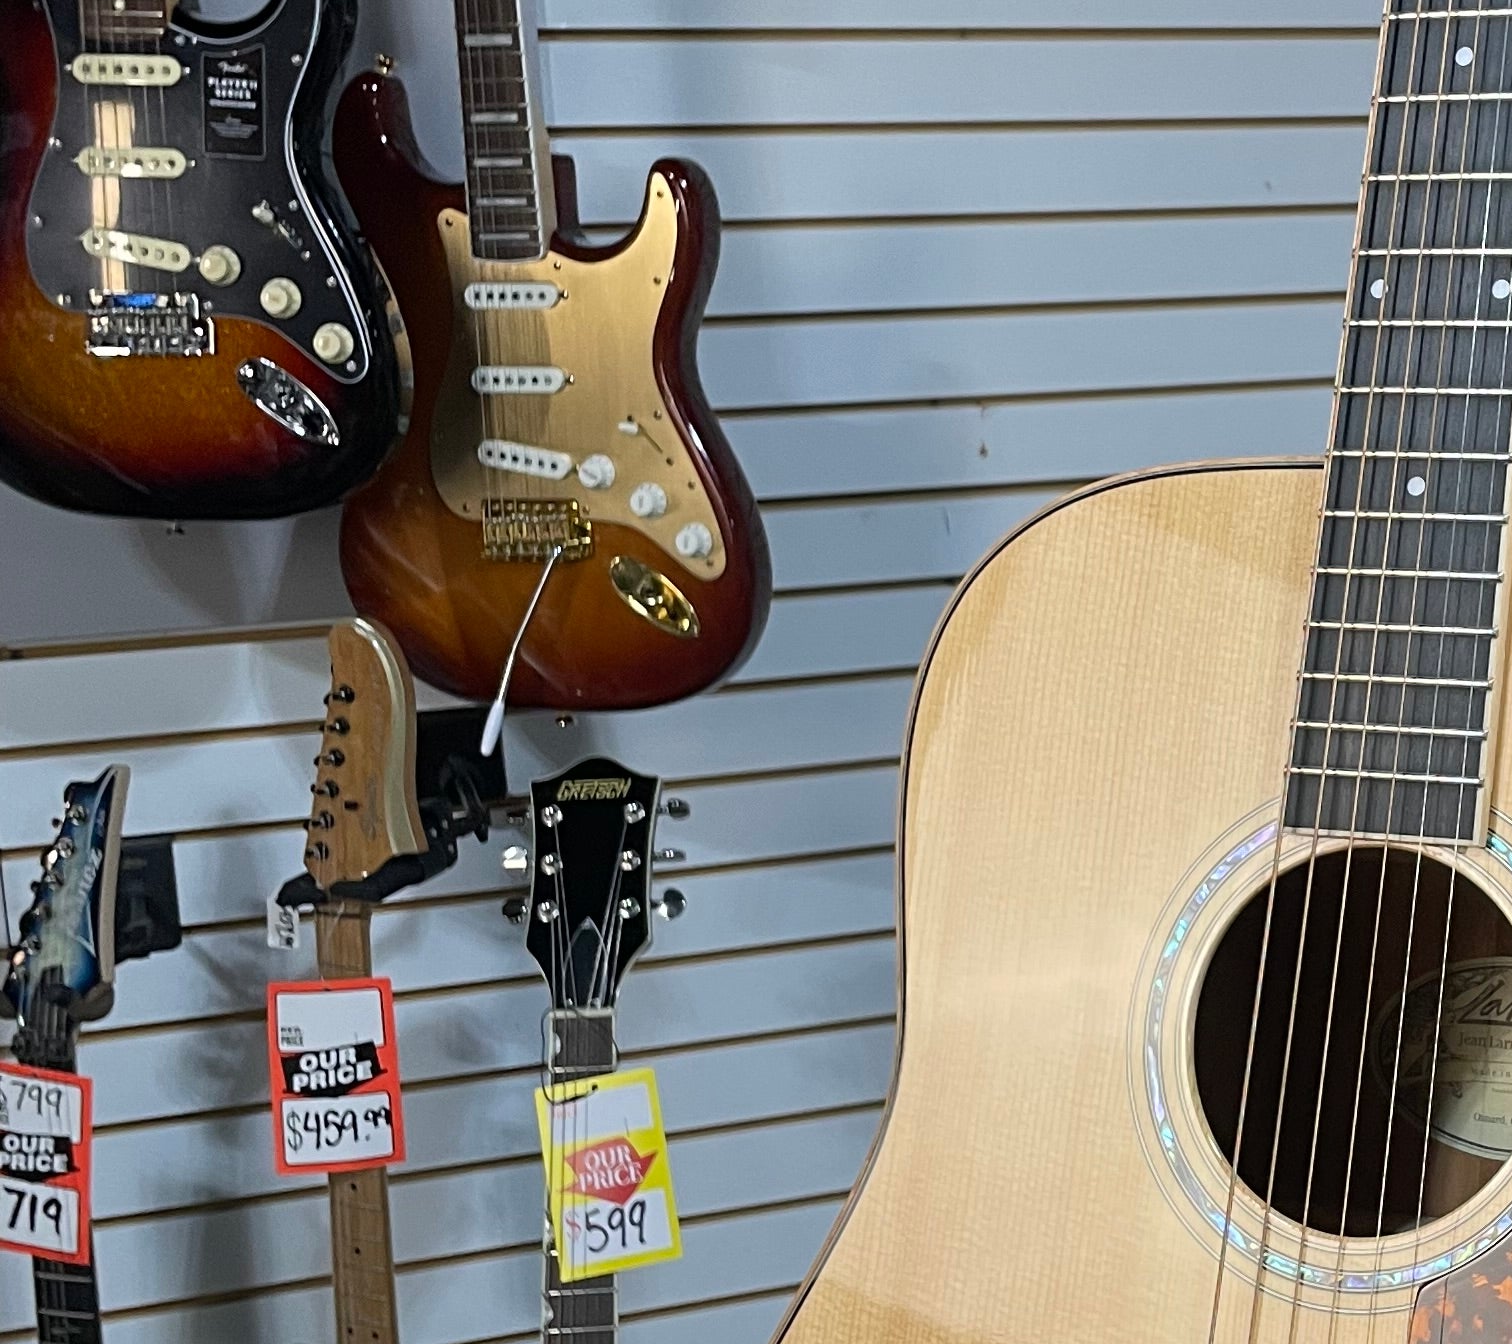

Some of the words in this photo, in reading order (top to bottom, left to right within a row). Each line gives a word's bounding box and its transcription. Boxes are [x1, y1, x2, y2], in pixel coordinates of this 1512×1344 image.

[1457, 1032, 1487, 1049] Jean
[300, 1047, 357, 1074] OUR
[292, 1060, 373, 1094] PRICE
[3, 1133, 56, 1154] OUR
[583, 1144, 634, 1170] OUR
[0, 1152, 69, 1173] PRICE
[579, 1160, 644, 1192] PRICE
[3, 1187, 63, 1236] 719
[565, 1199, 647, 1253] $599
